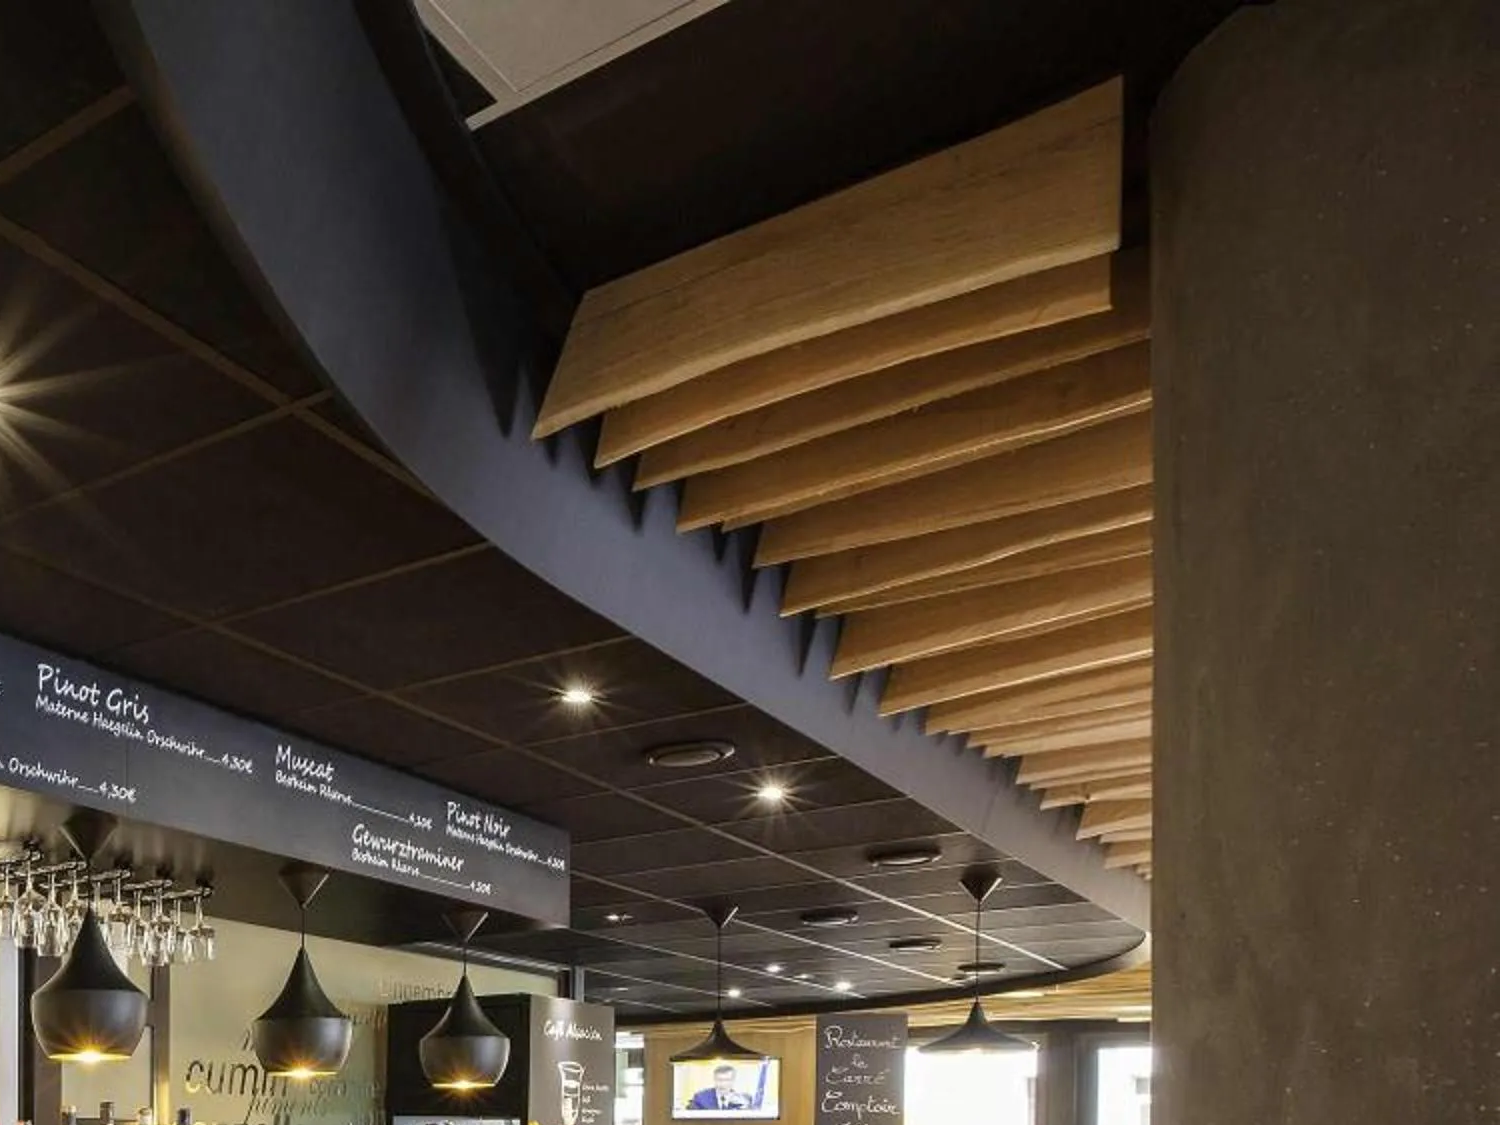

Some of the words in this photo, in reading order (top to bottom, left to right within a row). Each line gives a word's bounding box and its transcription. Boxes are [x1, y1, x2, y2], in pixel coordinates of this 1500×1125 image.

[35, 693, 88, 724] Materne
[37, 663, 100, 706] Pinot
[106, 688, 149, 725] Gris
[275, 744, 334, 782] Muscat
[447, 801, 481, 830] Pinot
[483, 813, 512, 838] Noir
